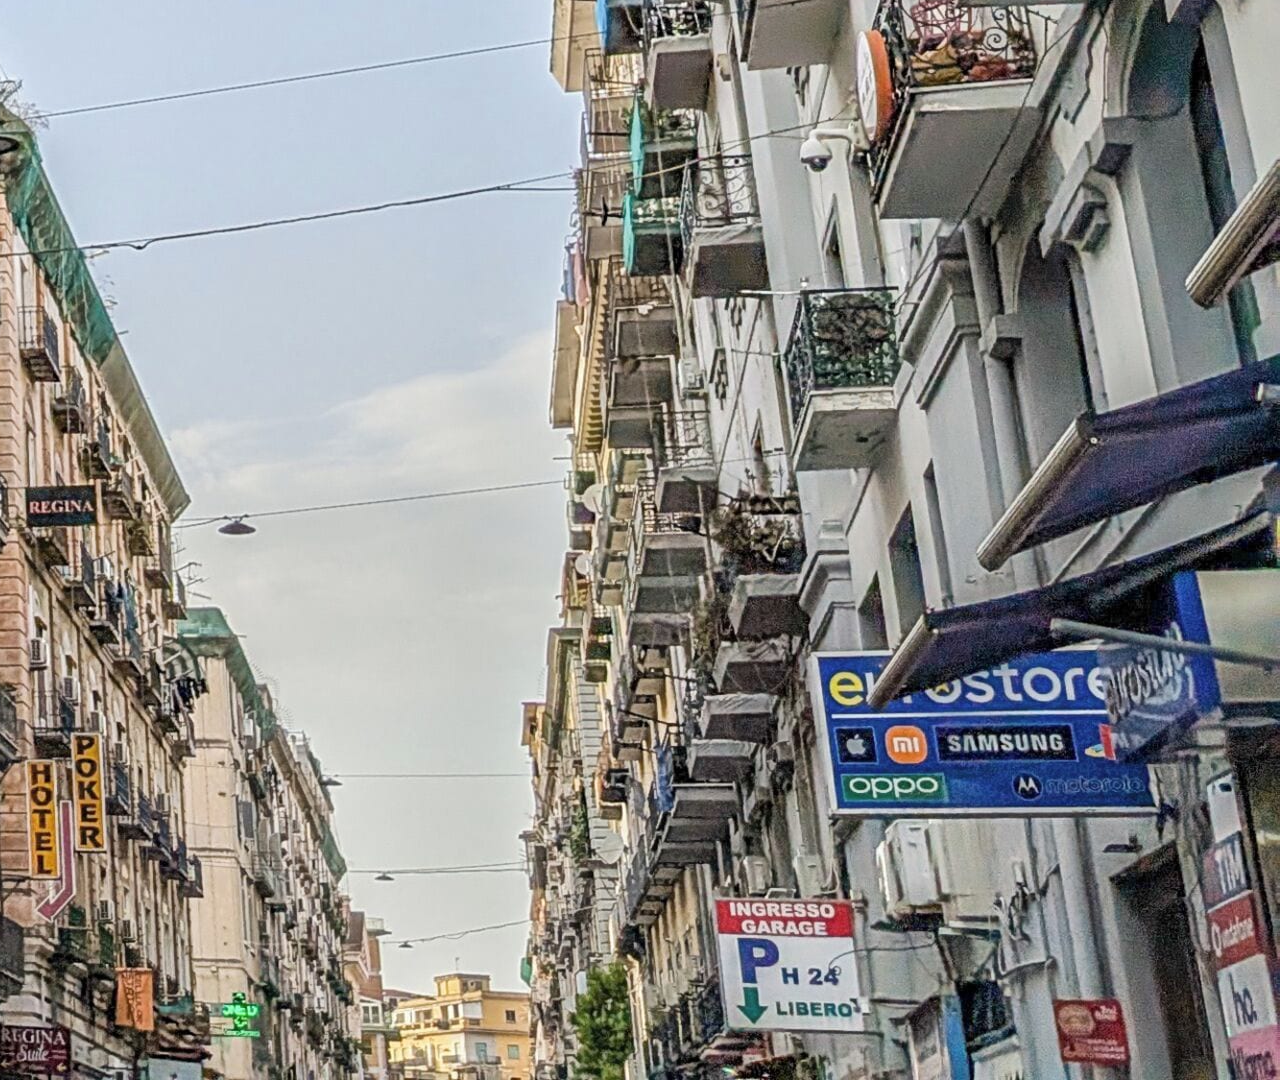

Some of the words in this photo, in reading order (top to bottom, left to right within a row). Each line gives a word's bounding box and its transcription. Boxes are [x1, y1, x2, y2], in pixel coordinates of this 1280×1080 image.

[29, 500, 94, 514] REGINA
[948, 732, 1065, 752] SAMSUNG
[74, 735, 102, 849] POKER
[849, 775, 939, 799] oppo
[1045, 774, 1145, 794] motorola
[30, 763, 53, 875] HOTEL
[1215, 840, 1246, 895] TIM
[729, 902, 836, 919] INGRESSO
[741, 919, 828, 936] GARAGE
[737, 938, 780, 984] P
[781, 968, 800, 985] H
[807, 968, 840, 985] 24
[776, 1001, 853, 1018] LIBERO
[1, 1028, 66, 1045] REGINA
